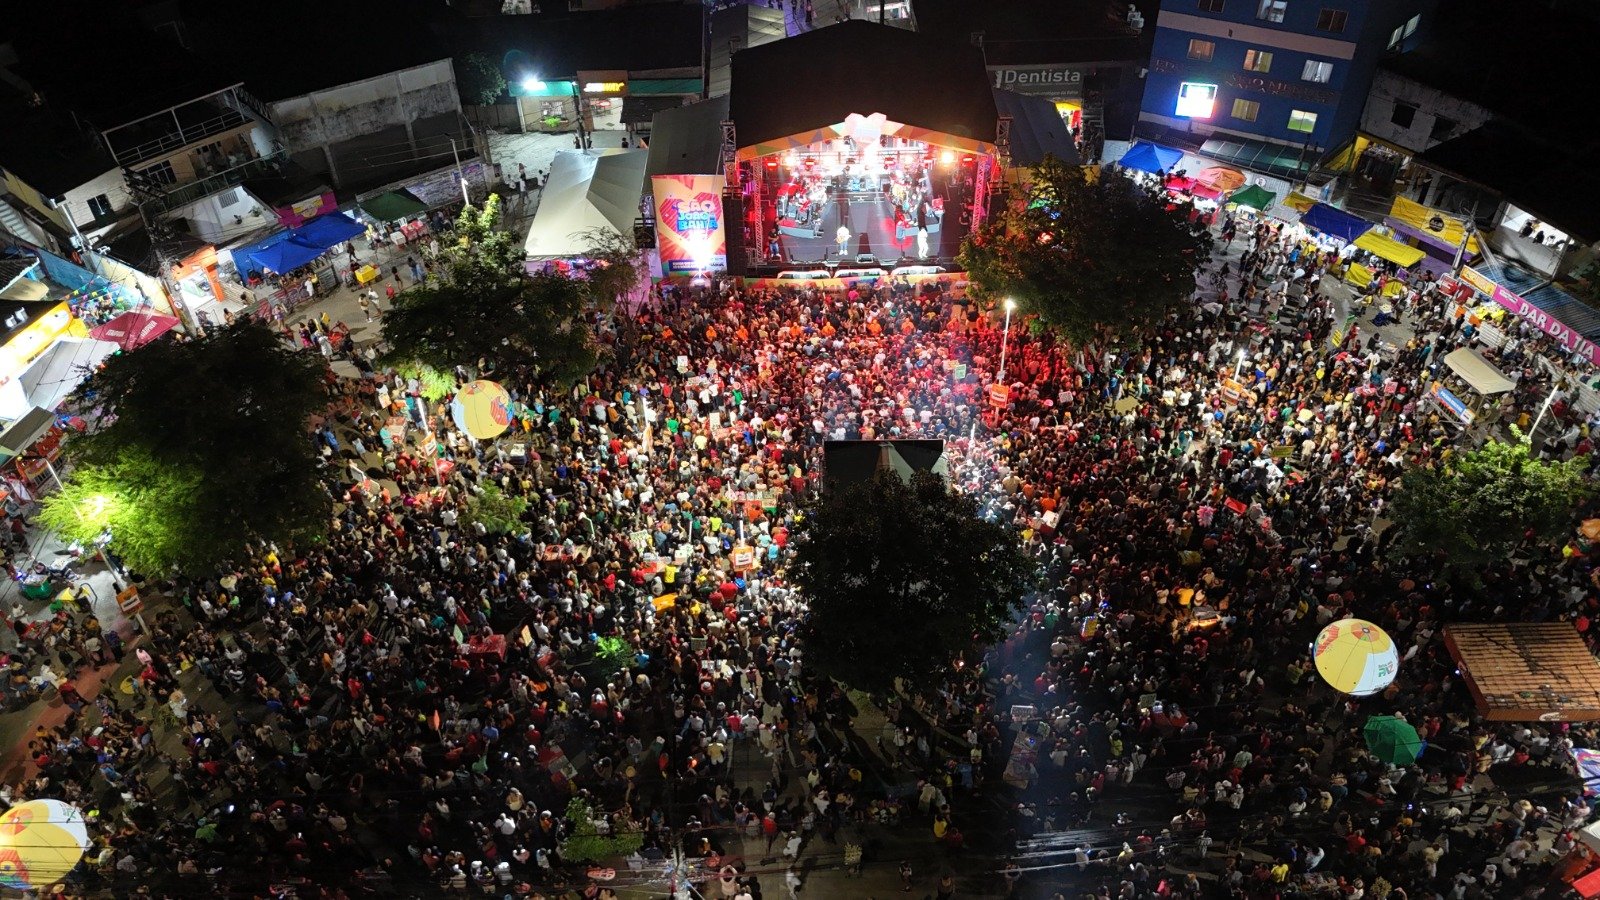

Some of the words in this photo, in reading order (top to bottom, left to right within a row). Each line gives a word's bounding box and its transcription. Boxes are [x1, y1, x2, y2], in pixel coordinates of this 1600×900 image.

[1005, 70, 1080, 83] Dentista
[677, 219, 718, 231] BAHIA
[1519, 303, 1547, 328] BAR
[1549, 322, 1570, 345] DA
[1574, 335, 1595, 359] TIA
